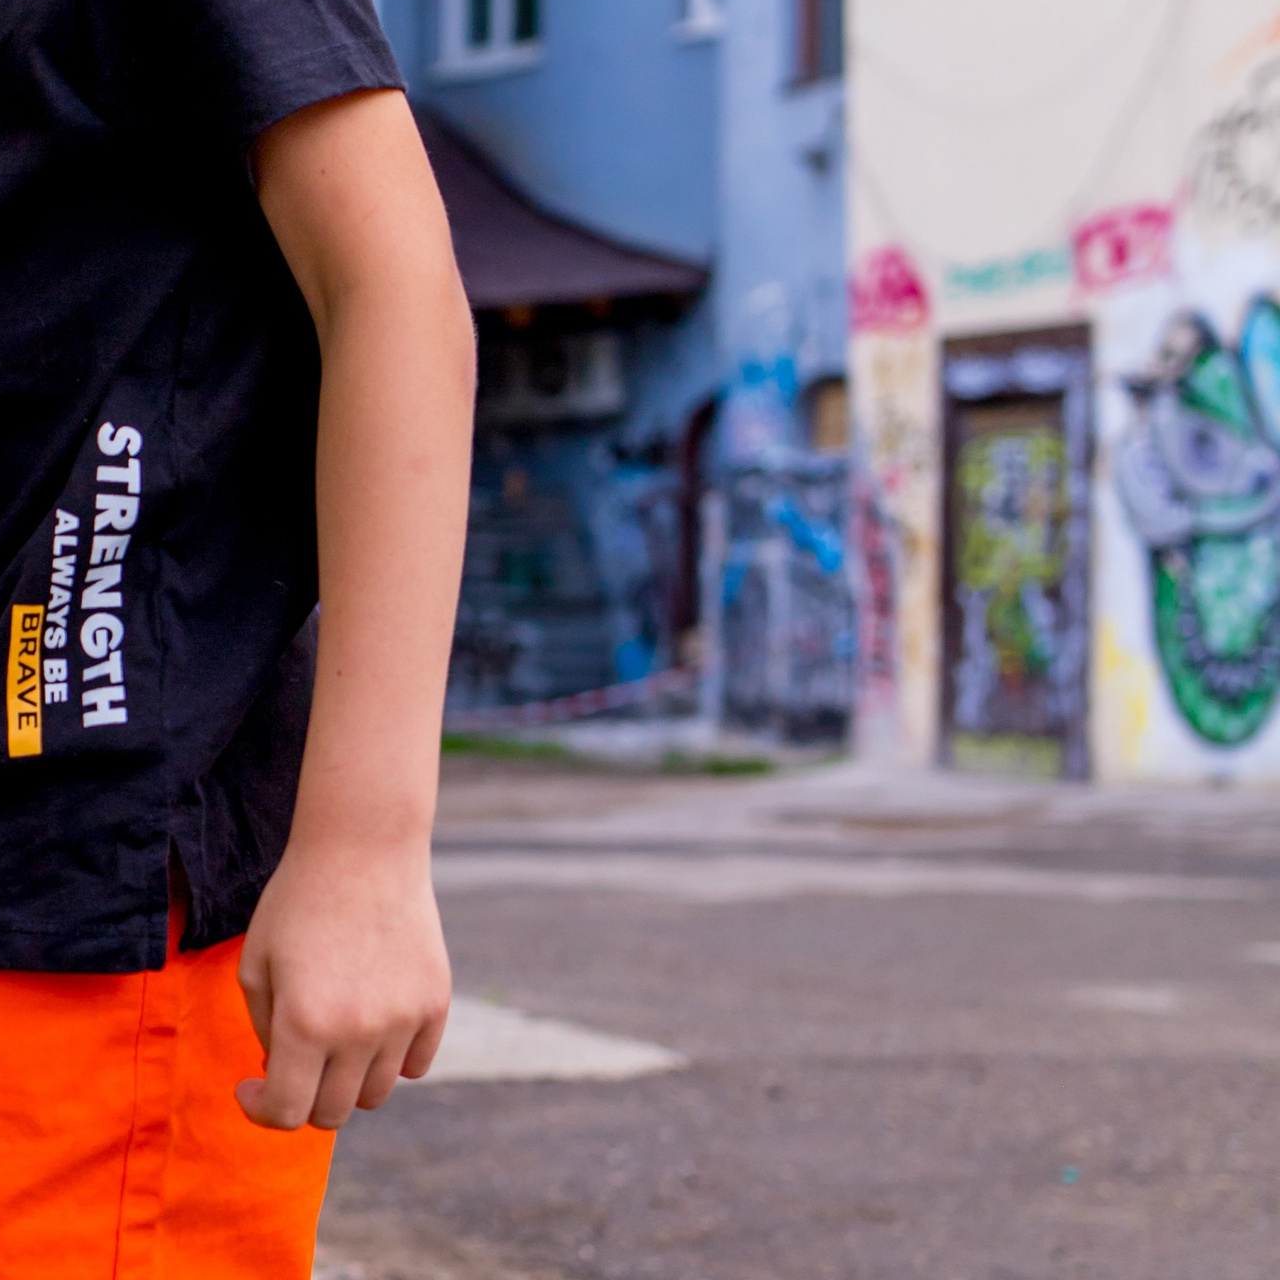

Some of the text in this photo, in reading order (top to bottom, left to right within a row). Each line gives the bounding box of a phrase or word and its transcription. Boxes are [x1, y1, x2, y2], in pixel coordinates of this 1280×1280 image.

[17, 612, 41, 731] BRAVE
[43, 508, 80, 705] ALWAYS BE
[80, 421, 144, 729] STRENGTH
